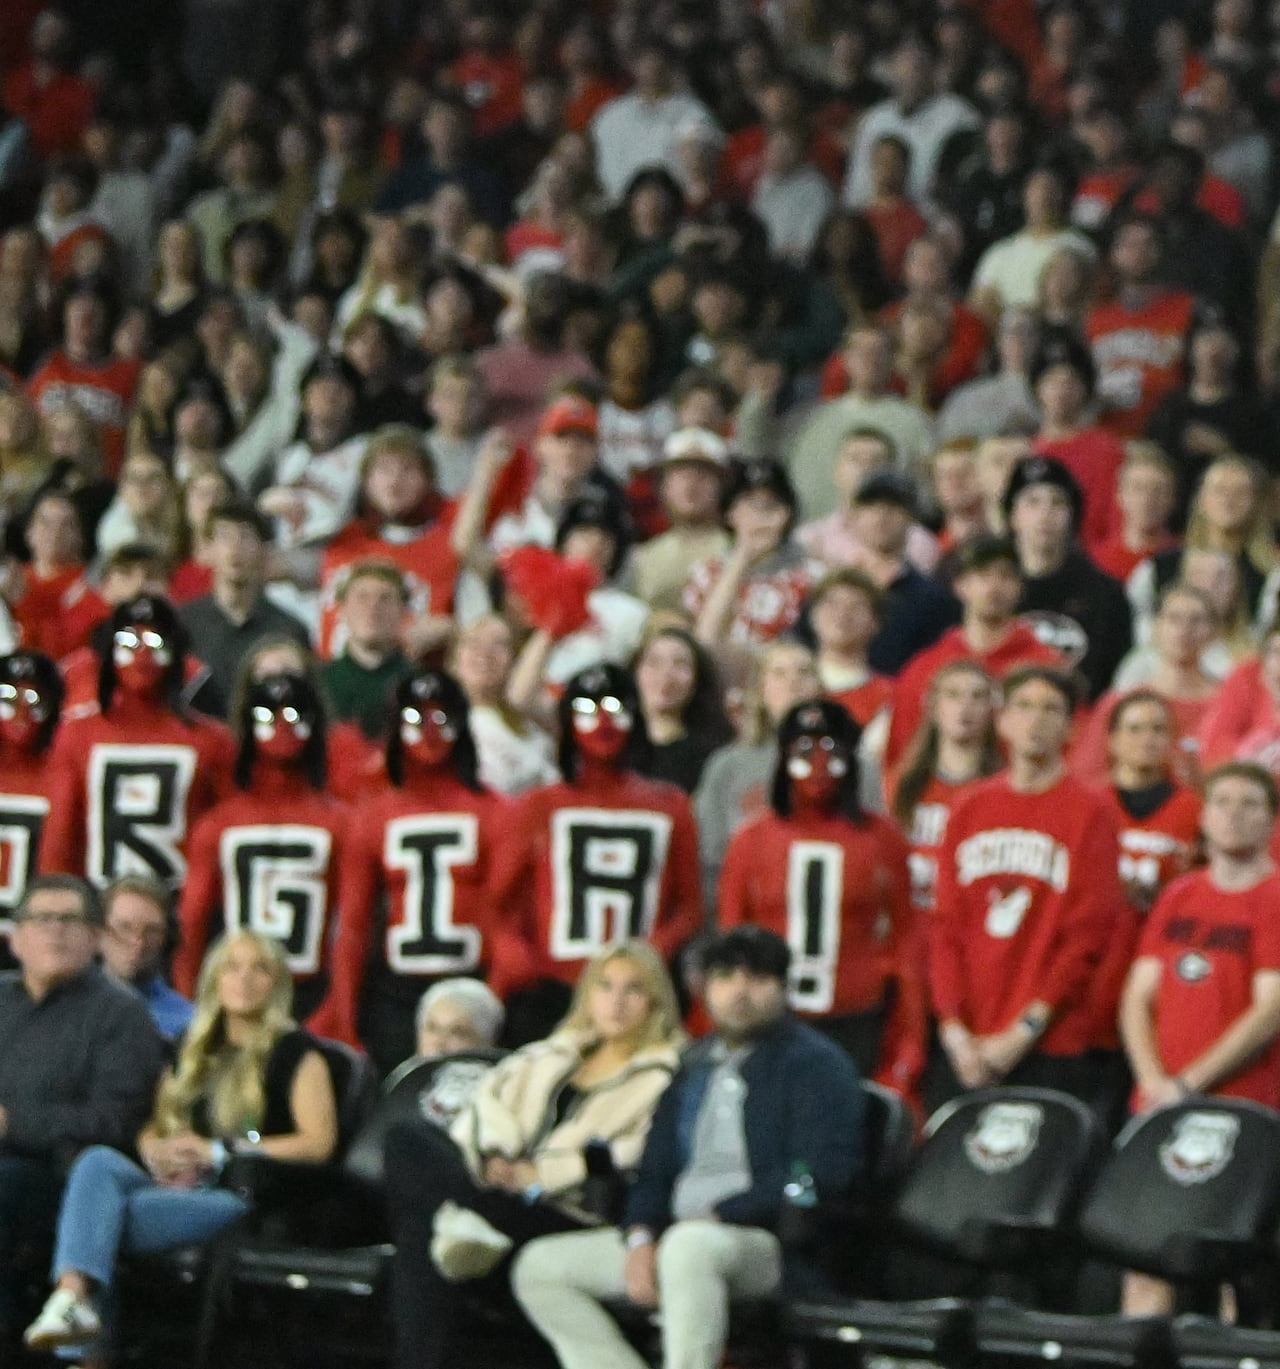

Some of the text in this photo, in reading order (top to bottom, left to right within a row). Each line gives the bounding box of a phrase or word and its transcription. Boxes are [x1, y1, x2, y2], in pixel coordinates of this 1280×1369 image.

[86, 744, 197, 892] R
[219, 824, 332, 973] G
[385, 812, 482, 974] I
[551, 808, 672, 960] A
